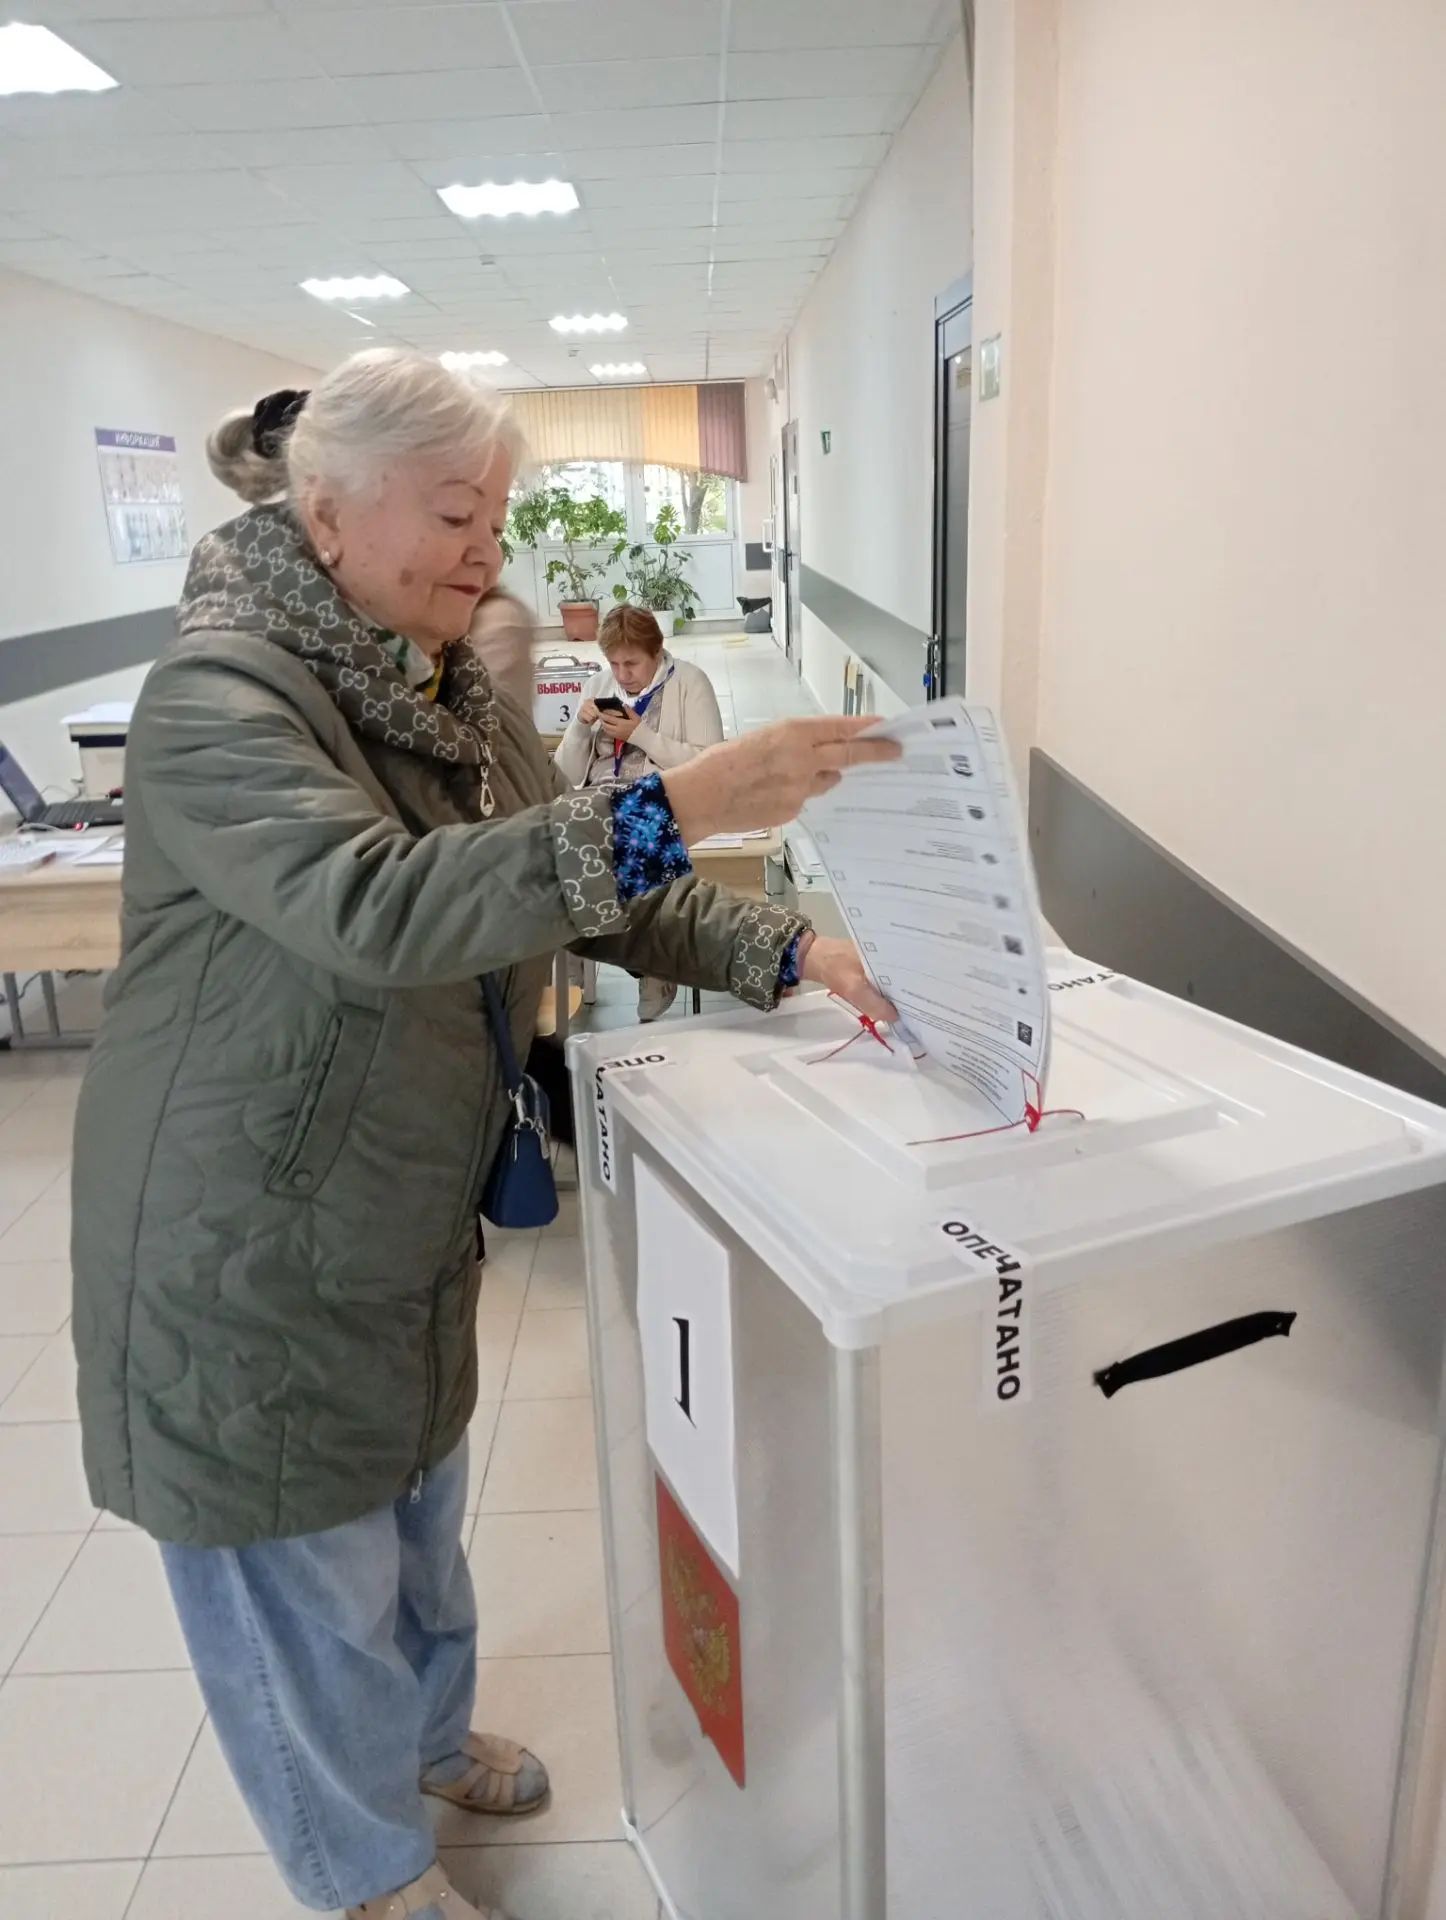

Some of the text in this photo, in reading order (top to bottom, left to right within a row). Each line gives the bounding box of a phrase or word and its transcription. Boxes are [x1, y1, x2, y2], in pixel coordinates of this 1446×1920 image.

[536, 682, 582, 695] ВЫБОРЫ
[559, 704, 571, 723] 3
[941, 1221, 1022, 1401] ОПЕЧАТАНО
[671, 1316, 698, 1430] 1
